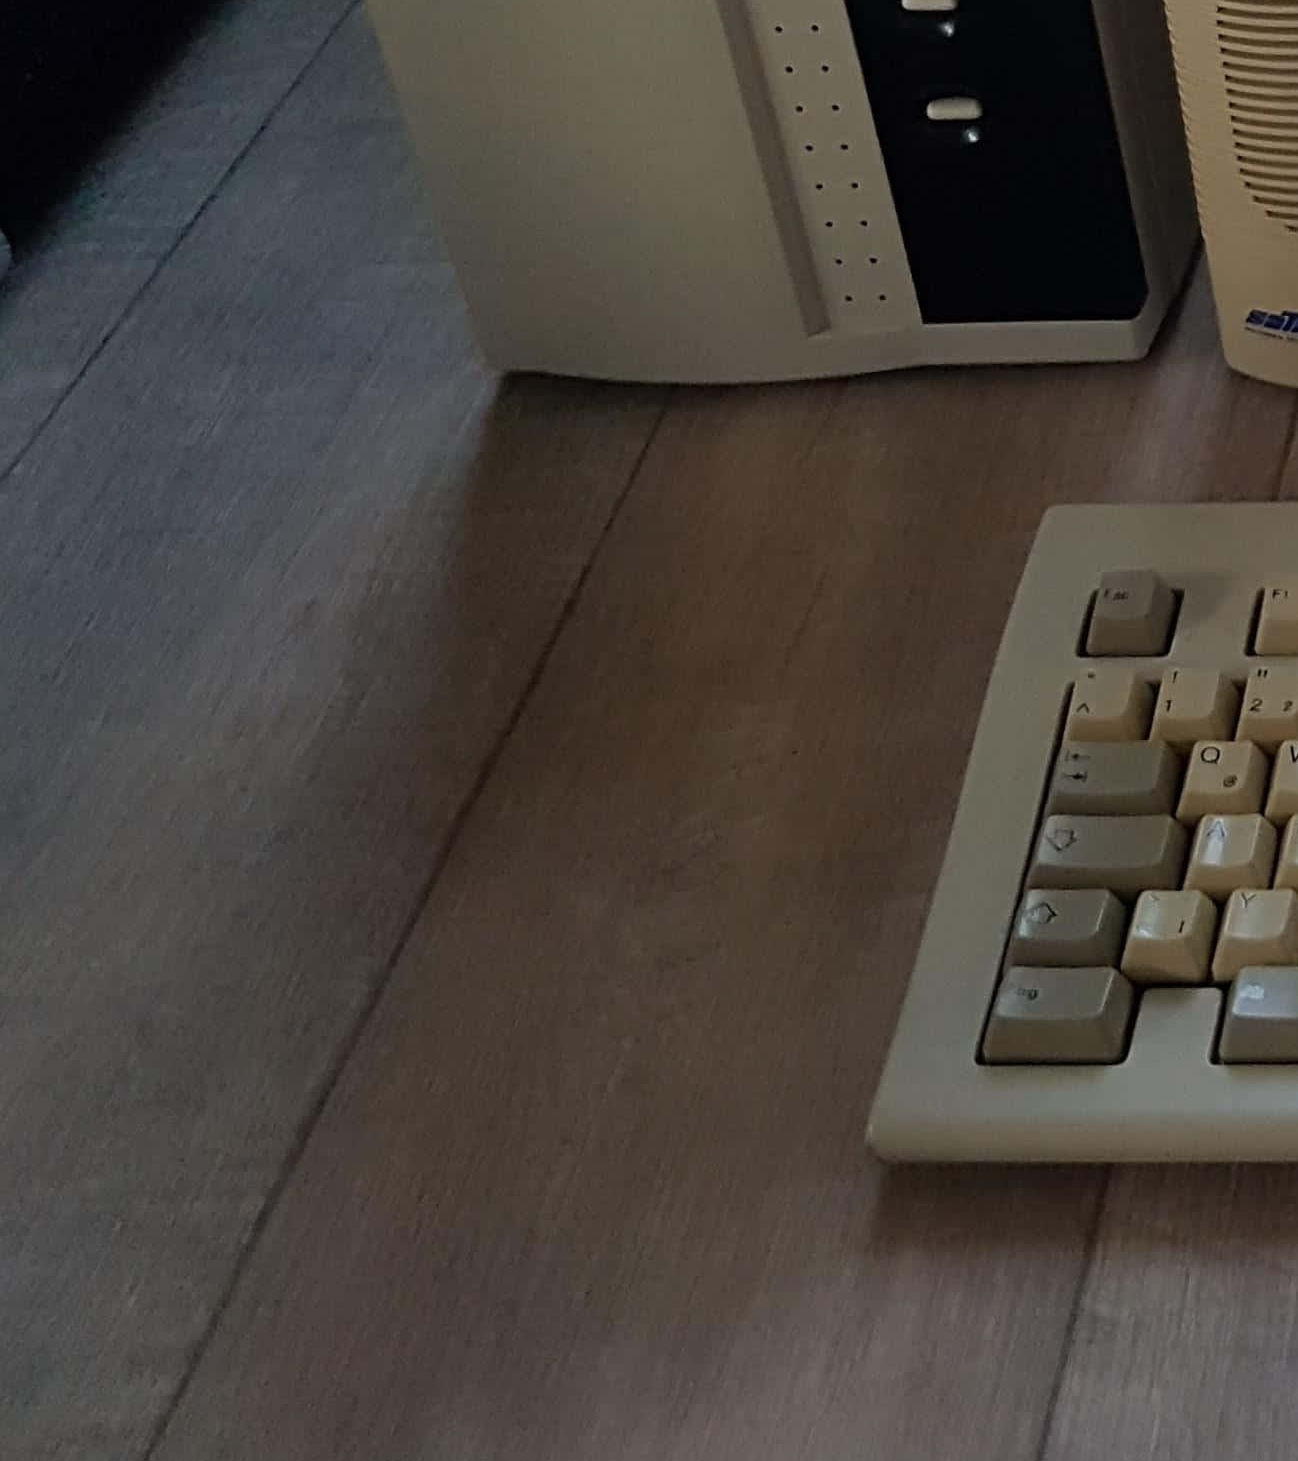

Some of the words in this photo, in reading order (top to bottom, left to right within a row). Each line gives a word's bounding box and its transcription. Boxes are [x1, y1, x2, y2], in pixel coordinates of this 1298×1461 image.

[1271, 589, 1289, 600] F1
[1165, 699, 1173, 712] 1
[1250, 698, 1263, 711] 2
[1200, 746, 1221, 764] Q
[1207, 819, 1225, 837] A
[1240, 893, 1256, 909] Y
